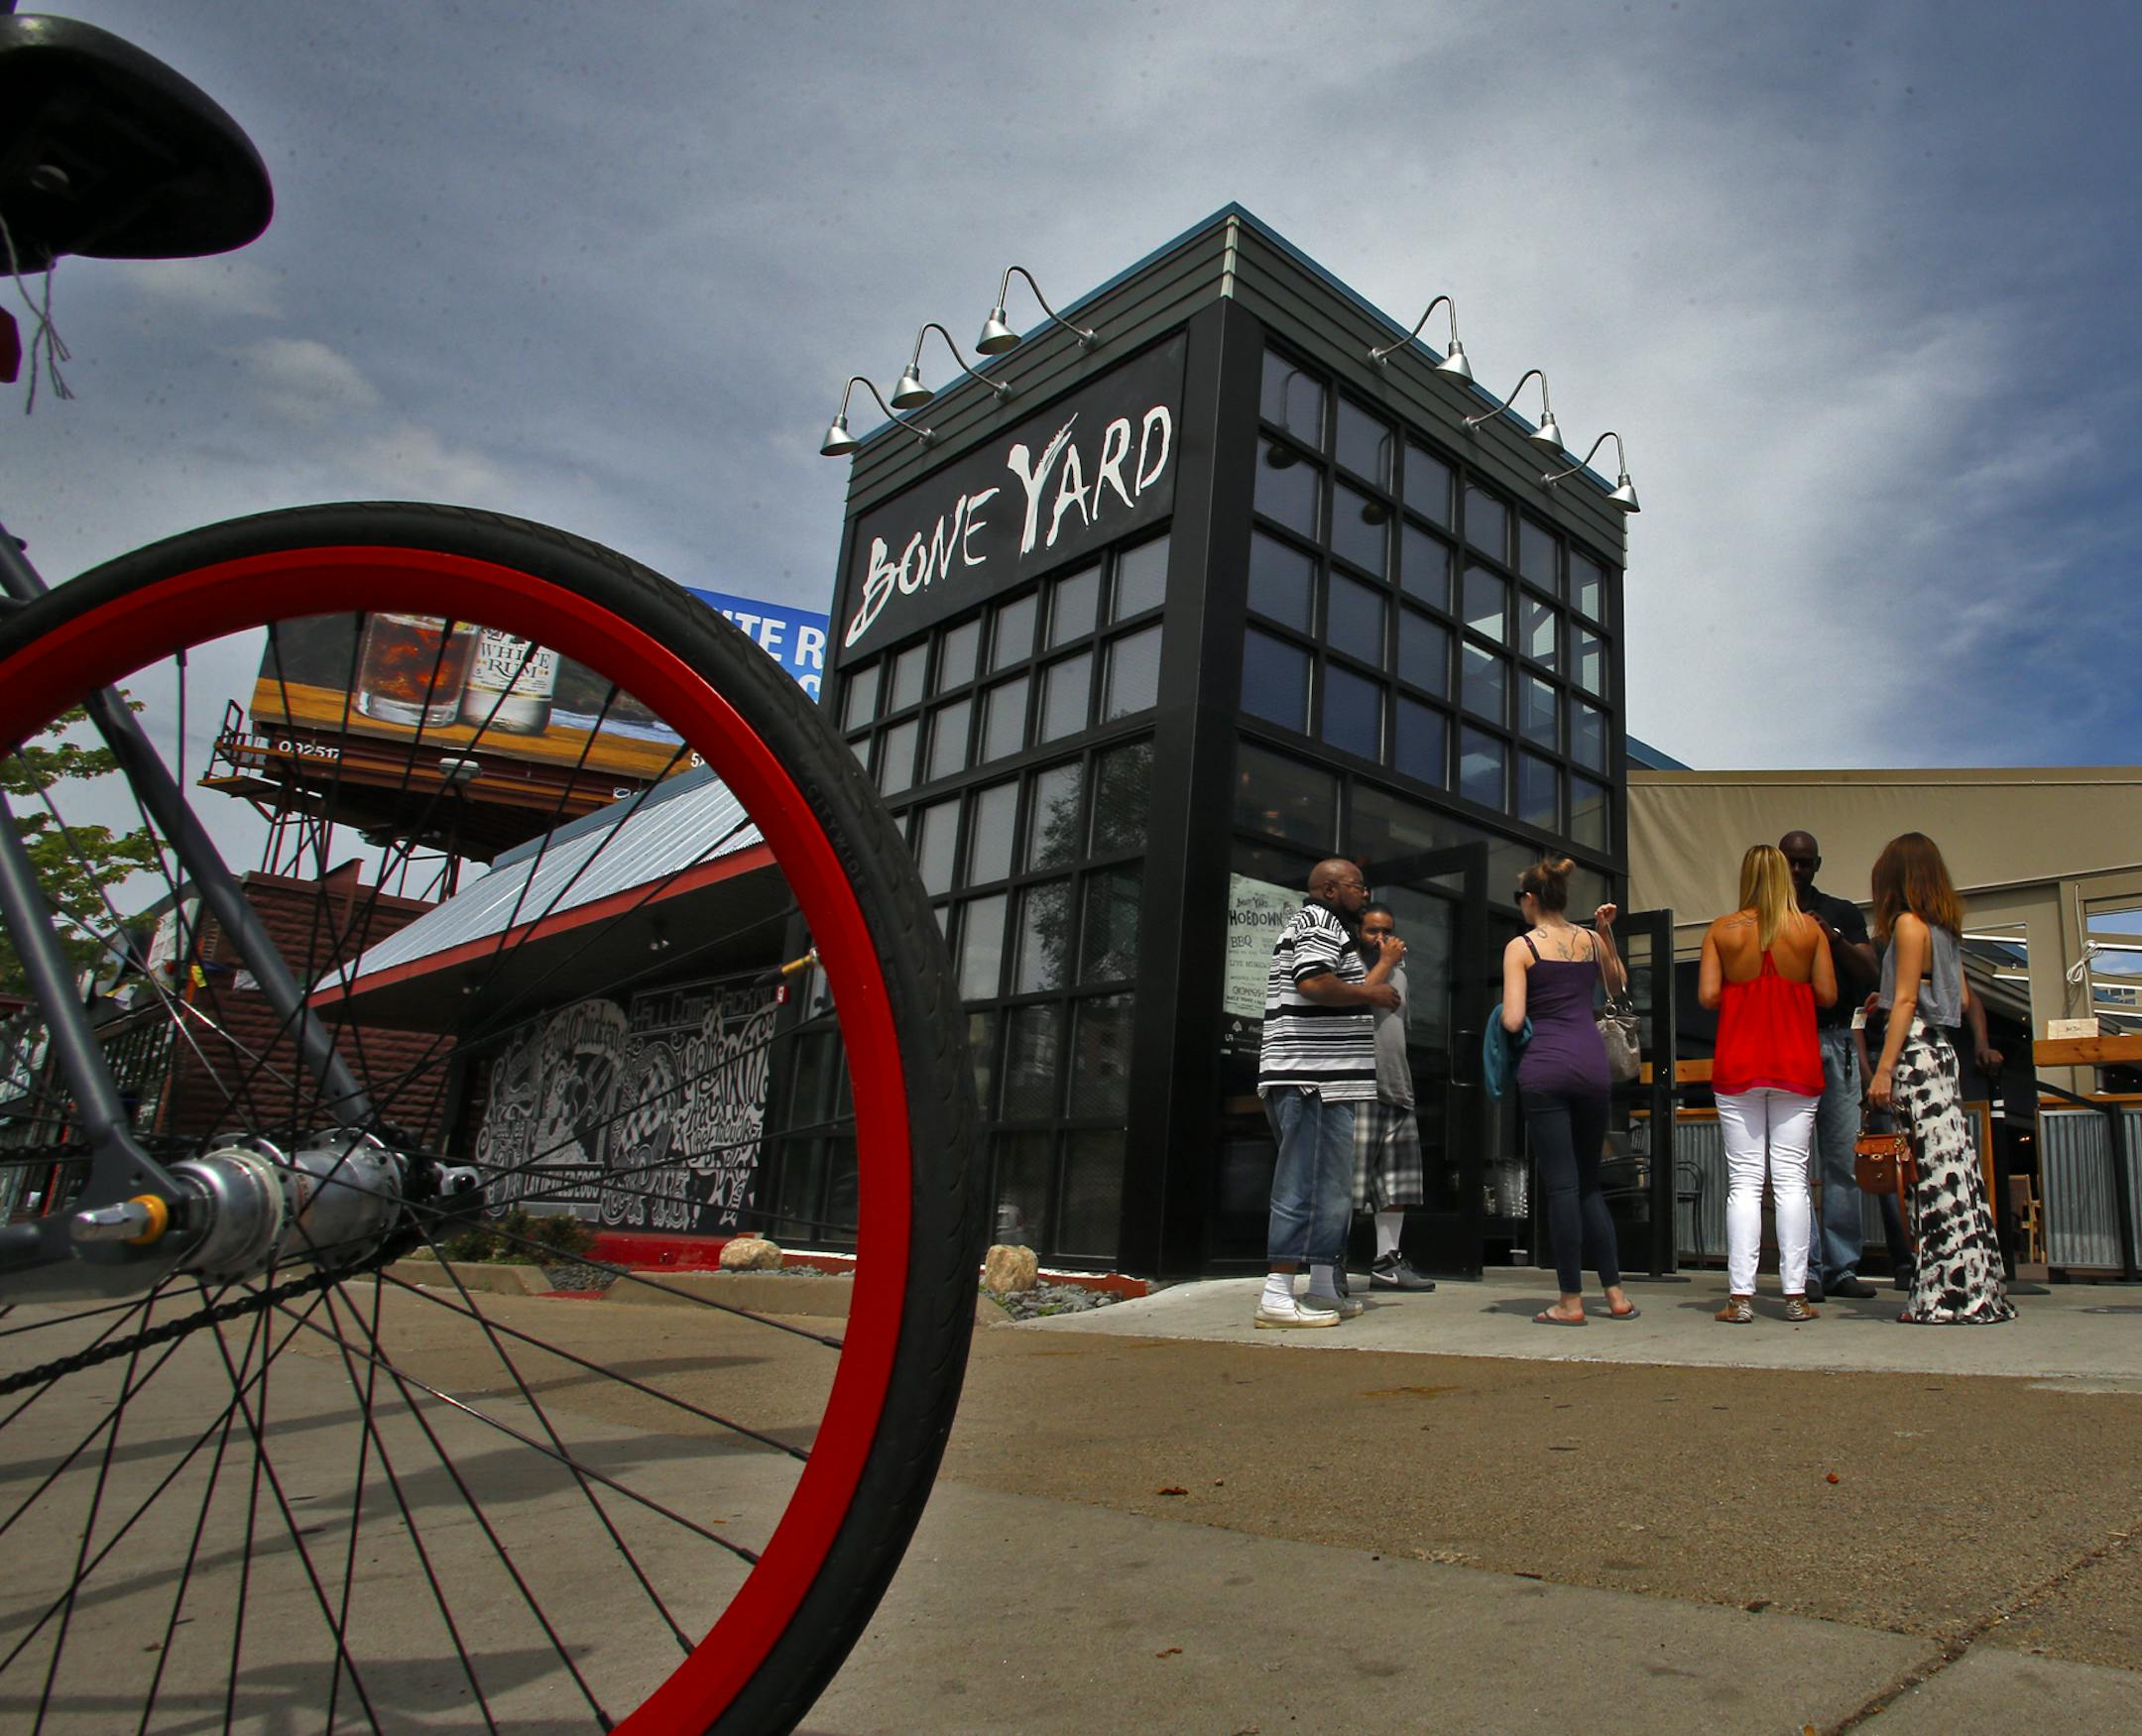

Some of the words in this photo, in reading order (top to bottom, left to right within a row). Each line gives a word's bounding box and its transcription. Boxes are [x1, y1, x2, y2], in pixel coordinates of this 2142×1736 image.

[845, 487, 1000, 648] BONE
[1007, 404, 1172, 563] YARD
[482, 642, 551, 669] WHIE
[1230, 909, 1283, 927] HOEDOWN
[1230, 935, 1253, 948] BBQ
